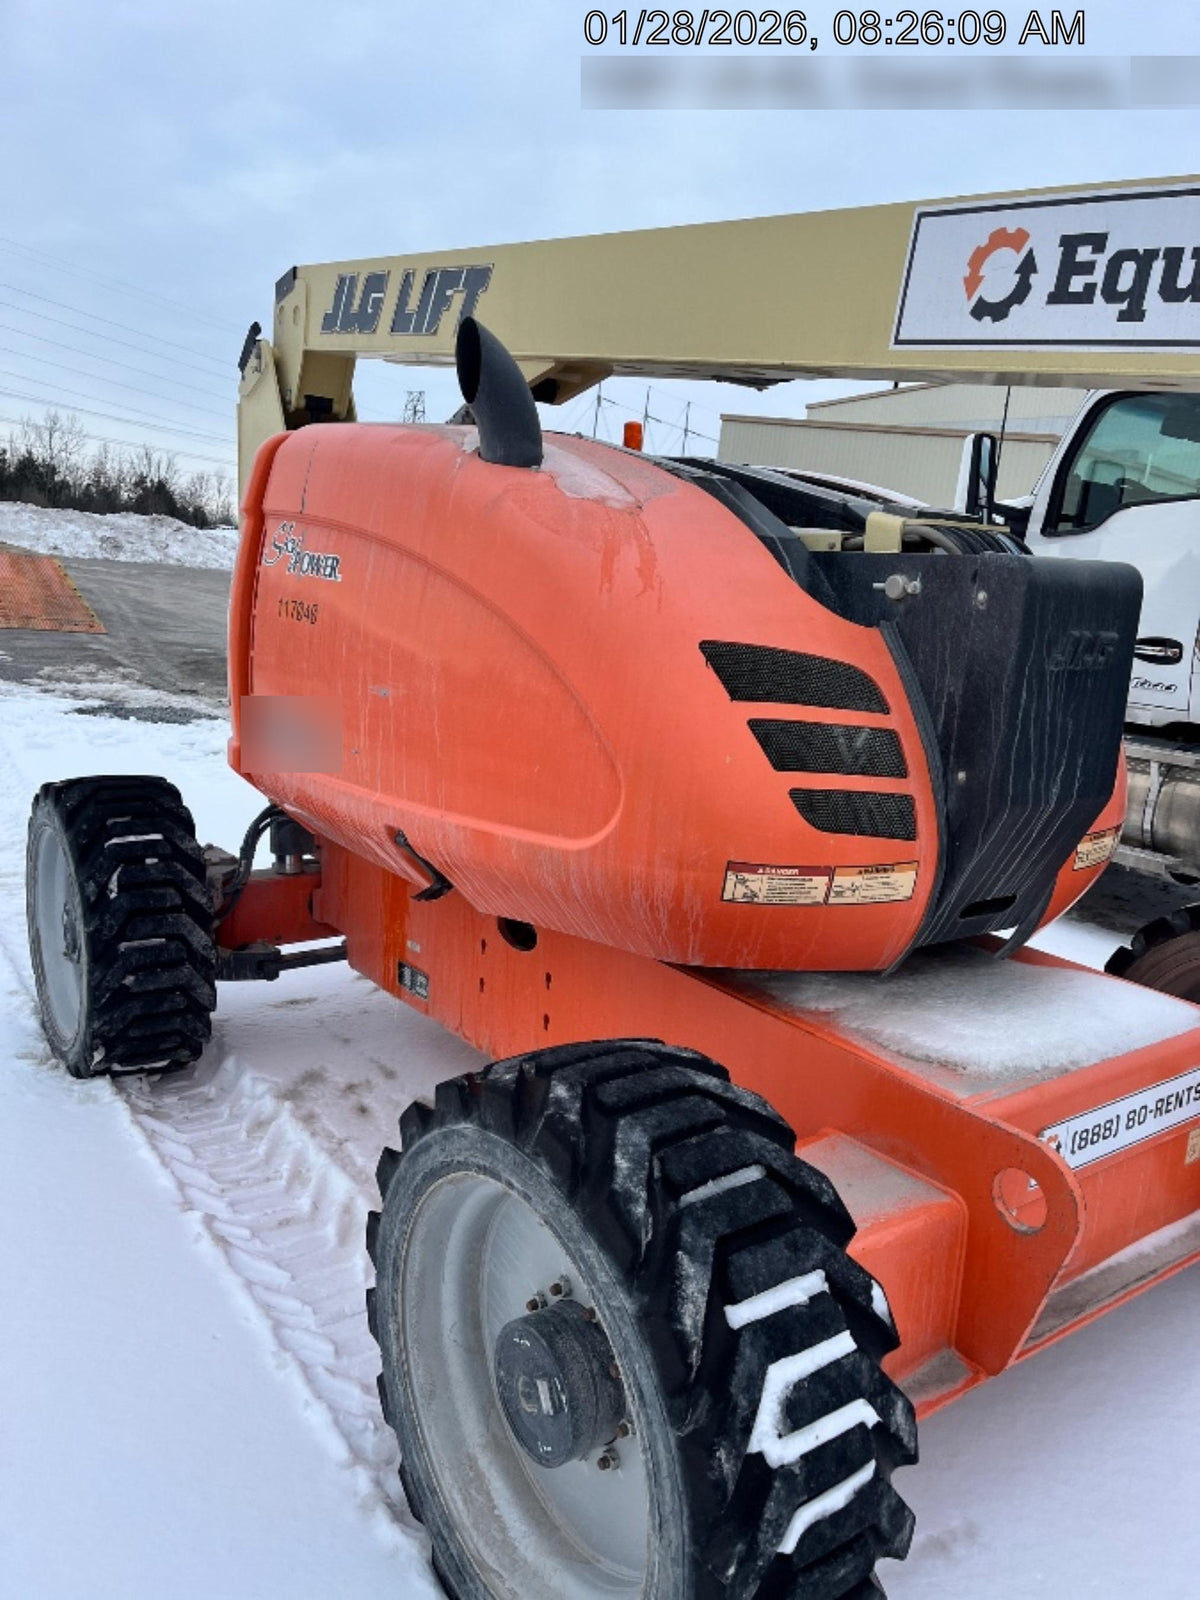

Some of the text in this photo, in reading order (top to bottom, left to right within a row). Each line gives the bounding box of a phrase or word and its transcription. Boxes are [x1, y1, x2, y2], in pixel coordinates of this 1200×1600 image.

[320, 263, 494, 336] JLG LIFT
[1046, 231, 1200, 322] Equ
[1070, 1083, 1200, 1156] (888) 80-RENTS
